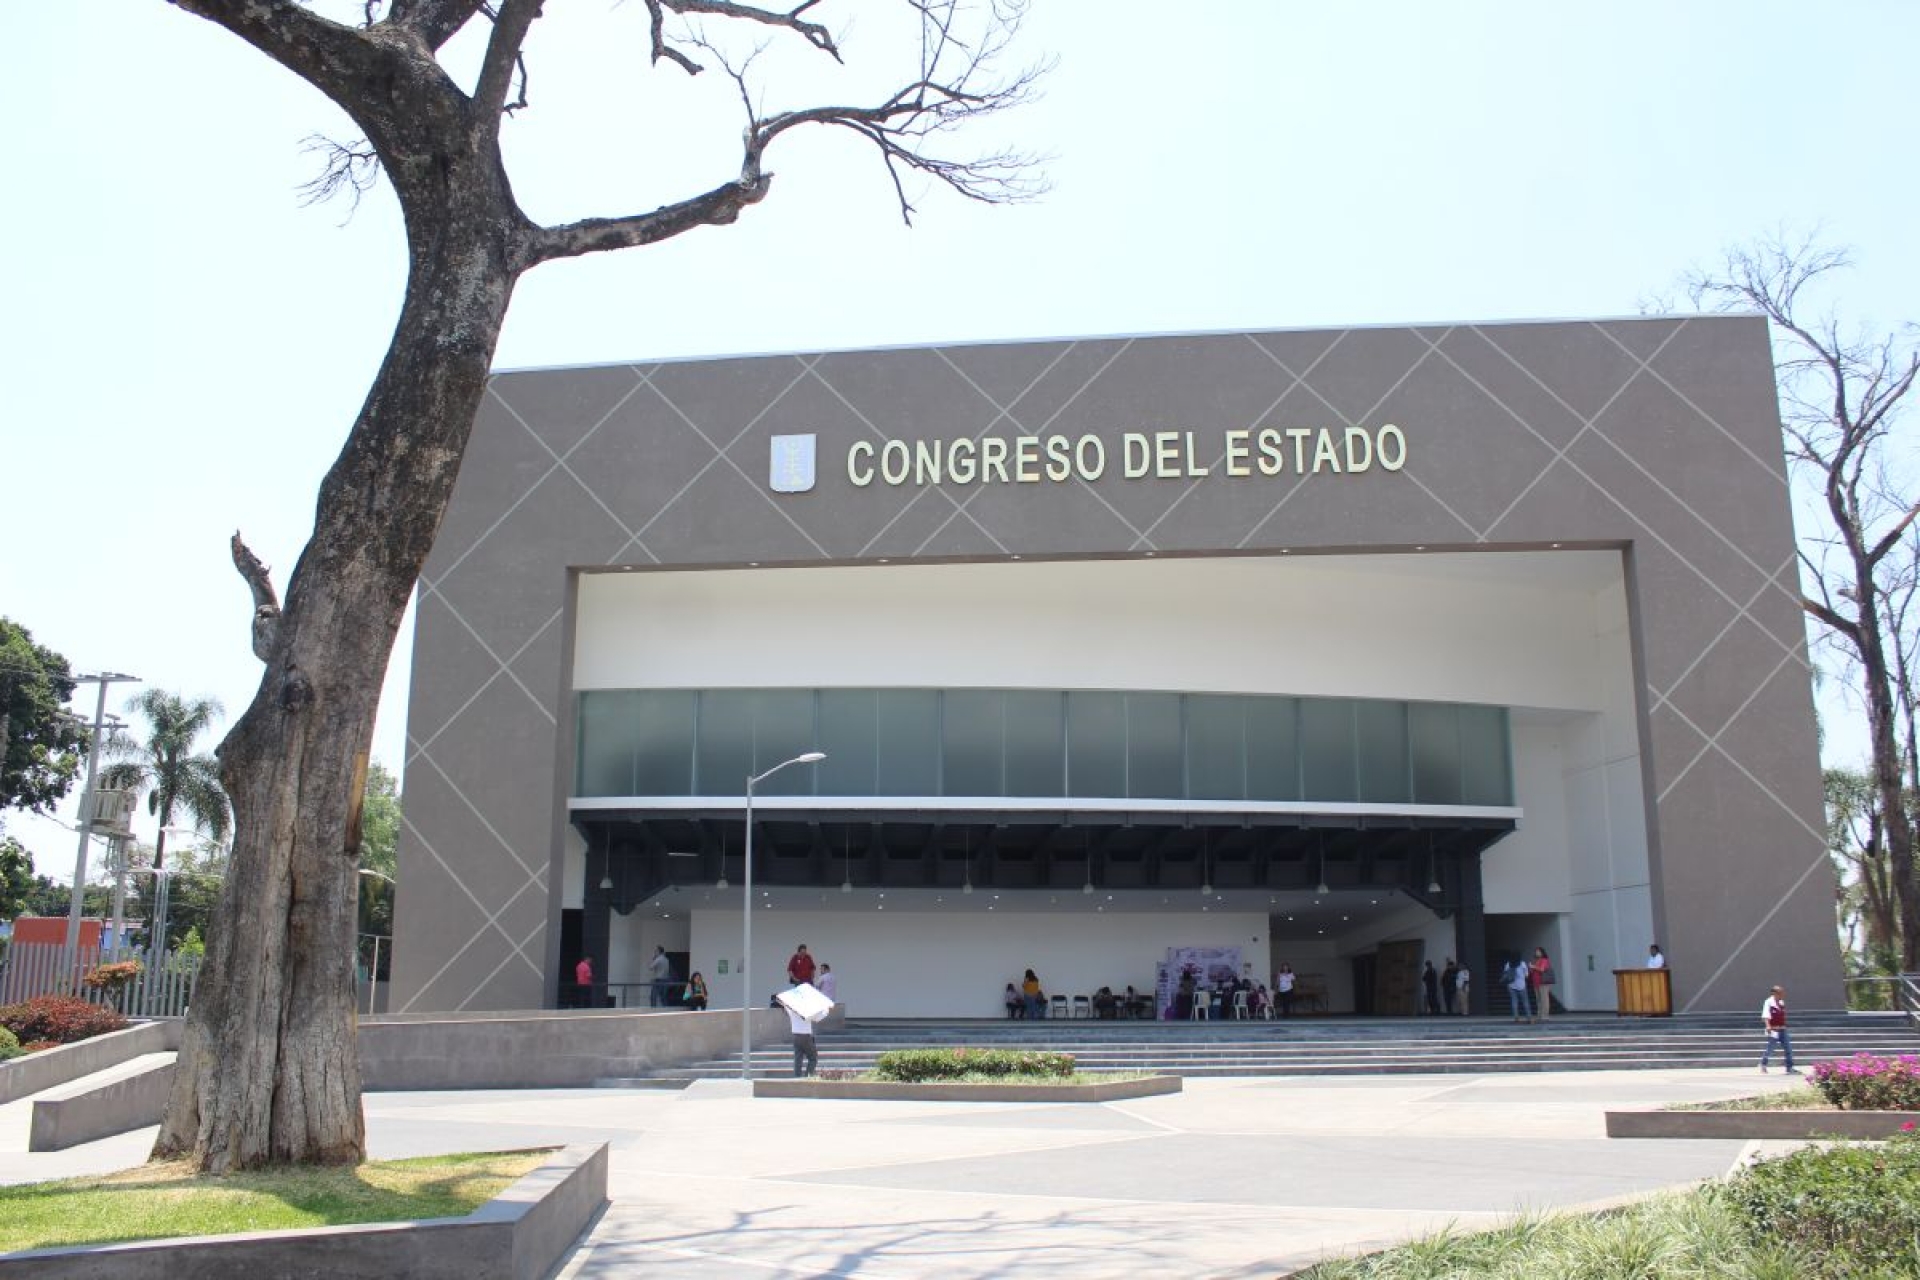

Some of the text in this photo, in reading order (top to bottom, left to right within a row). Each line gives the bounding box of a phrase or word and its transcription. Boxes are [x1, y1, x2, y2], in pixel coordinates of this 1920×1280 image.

[847, 424, 1408, 486] CONGRESO DEL ESTADO
